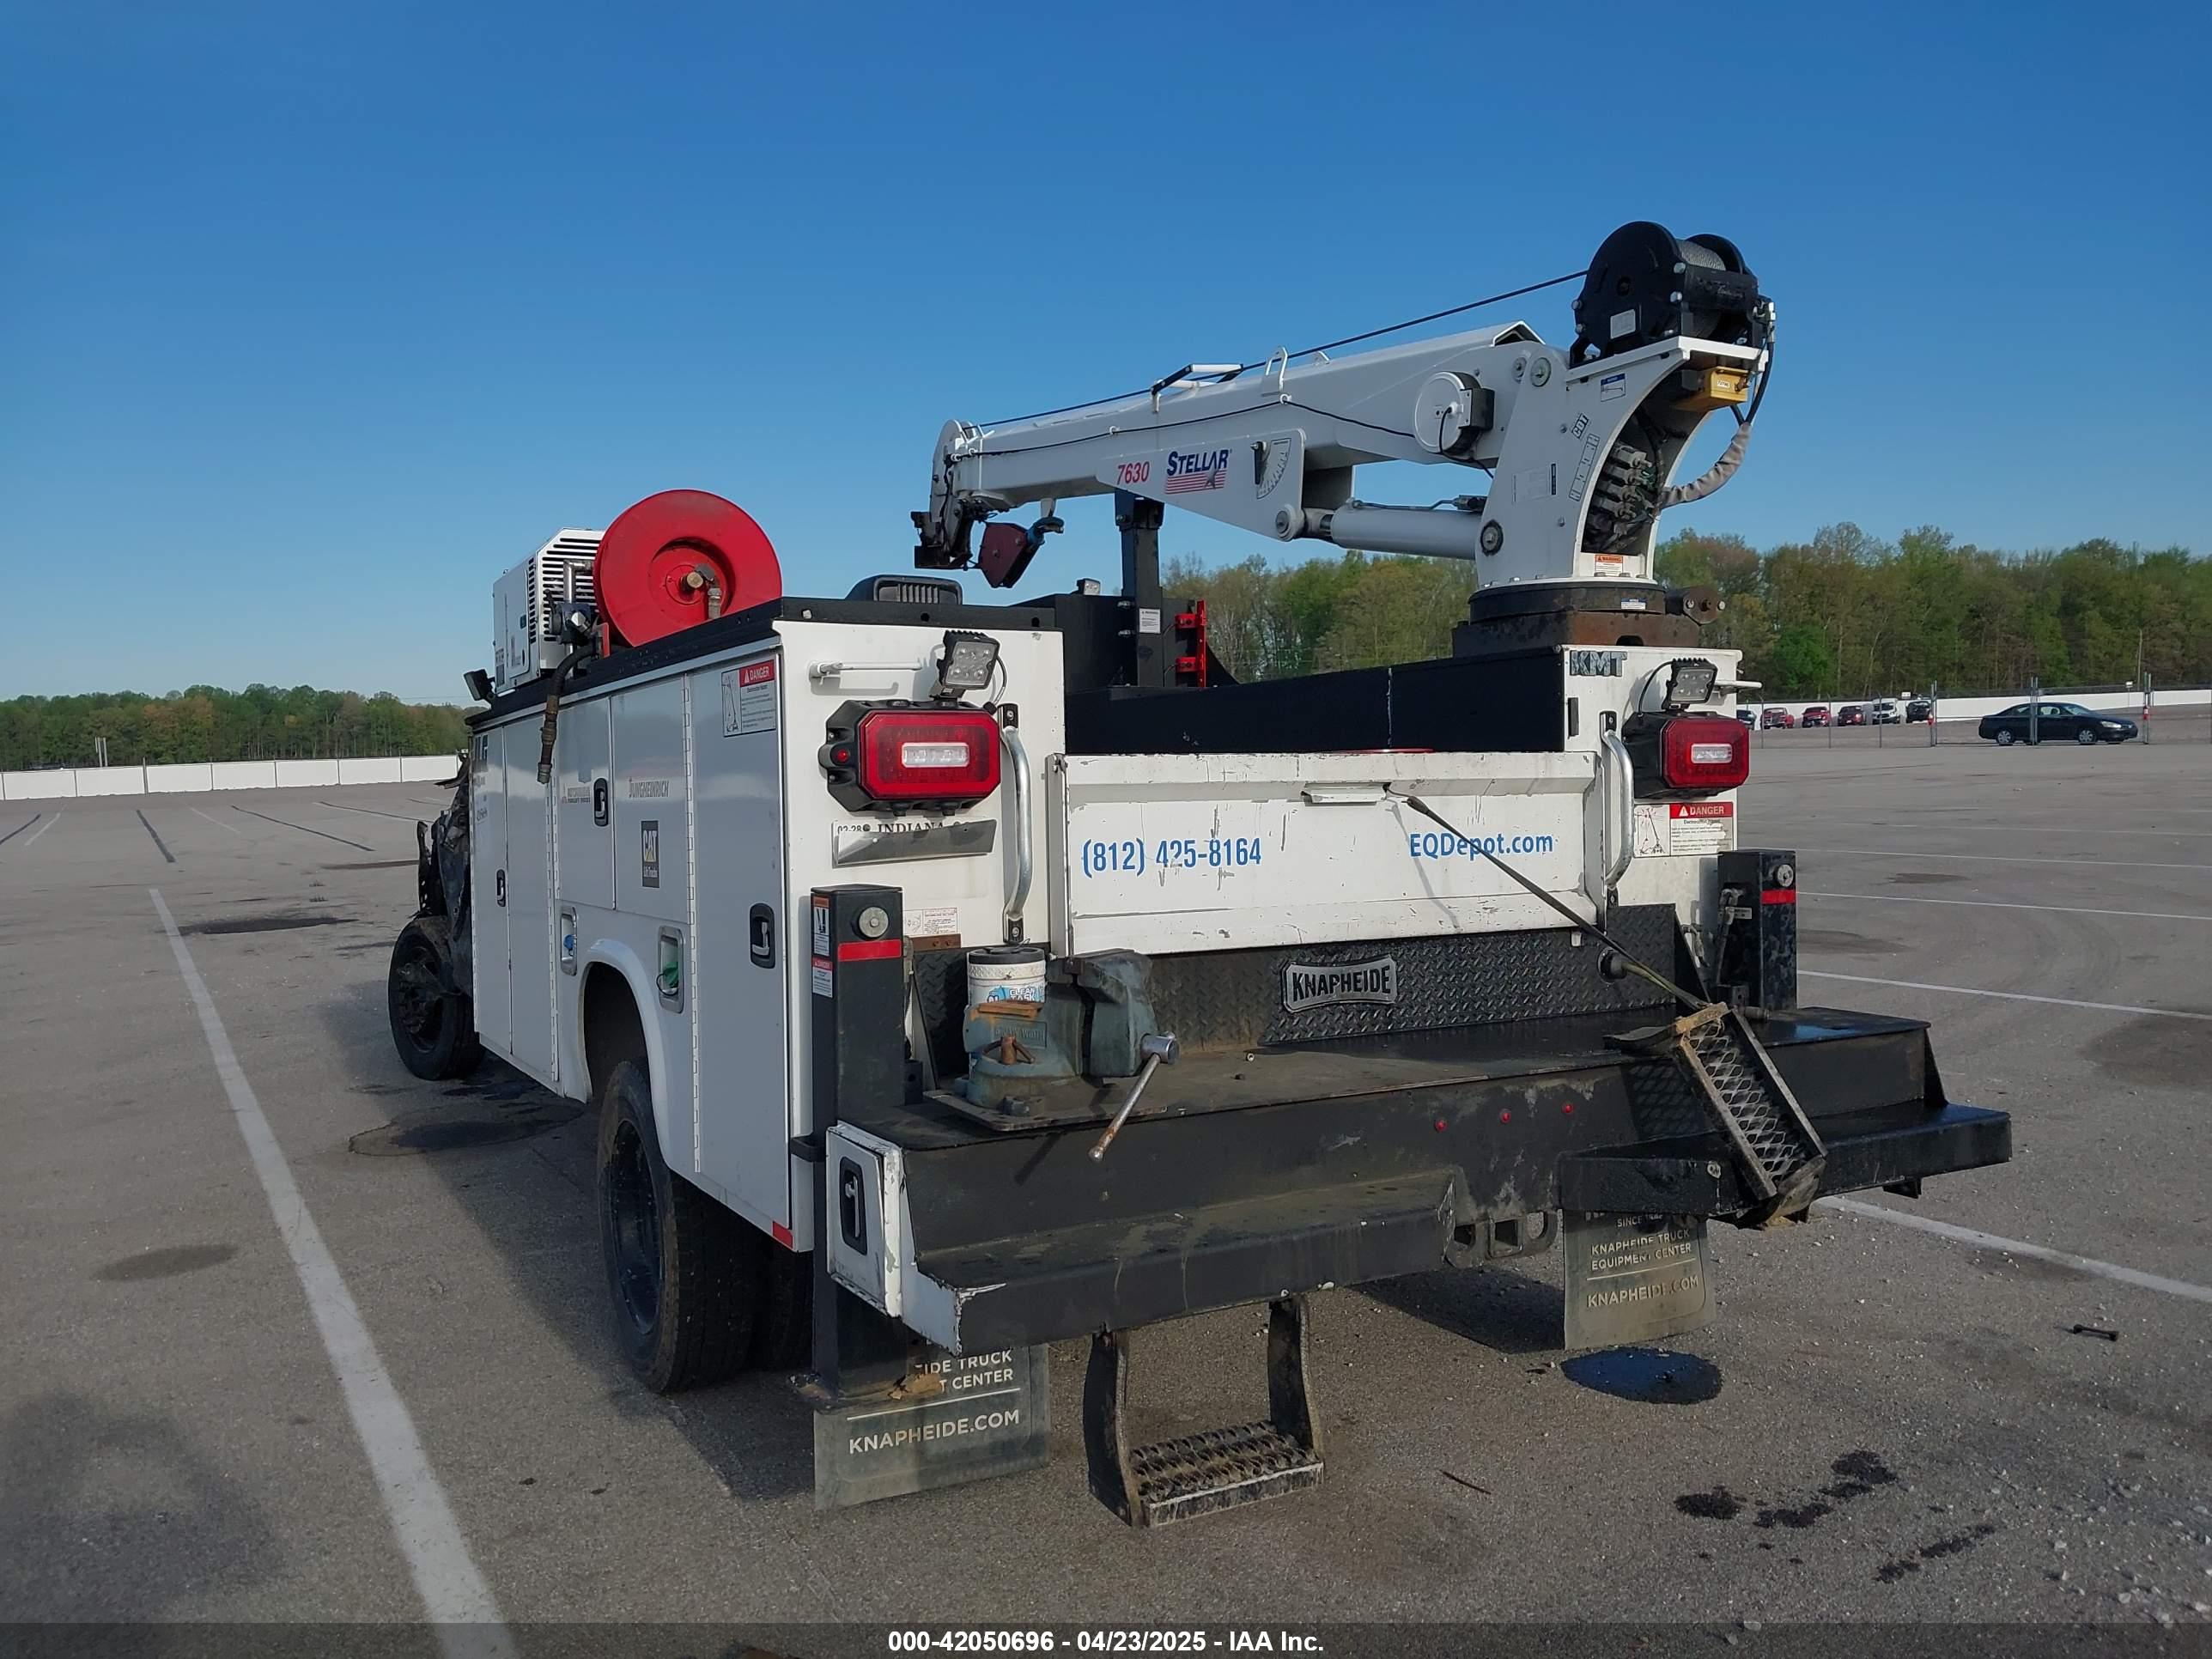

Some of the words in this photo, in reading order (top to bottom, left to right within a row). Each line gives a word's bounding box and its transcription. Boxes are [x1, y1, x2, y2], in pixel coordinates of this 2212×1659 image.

[1117, 461, 1150, 485] 7630
[1167, 450, 1229, 476] STELLAR
[750, 666, 769, 680] DANGER
[1570, 650, 1627, 677] KMT
[1690, 806, 1724, 815] DANGER
[643, 830, 657, 862] CAT
[1083, 837, 1146, 878] (812)
[1156, 837, 1262, 868] 425-8164
[1410, 833, 1553, 861] EQDepot.com
[1010, 988, 1035, 996] CLEAN
[1292, 964, 1391, 1002] KNAPHEIDE
[1658, 1229, 1690, 1243] TRUCK
[1656, 1243, 1692, 1260] CENTER
[958, 1349, 1012, 1370] TRUCK
[952, 1368, 1013, 1389] CENTER
[849, 1409, 1020, 1455] KNAPHEIDE.COM
